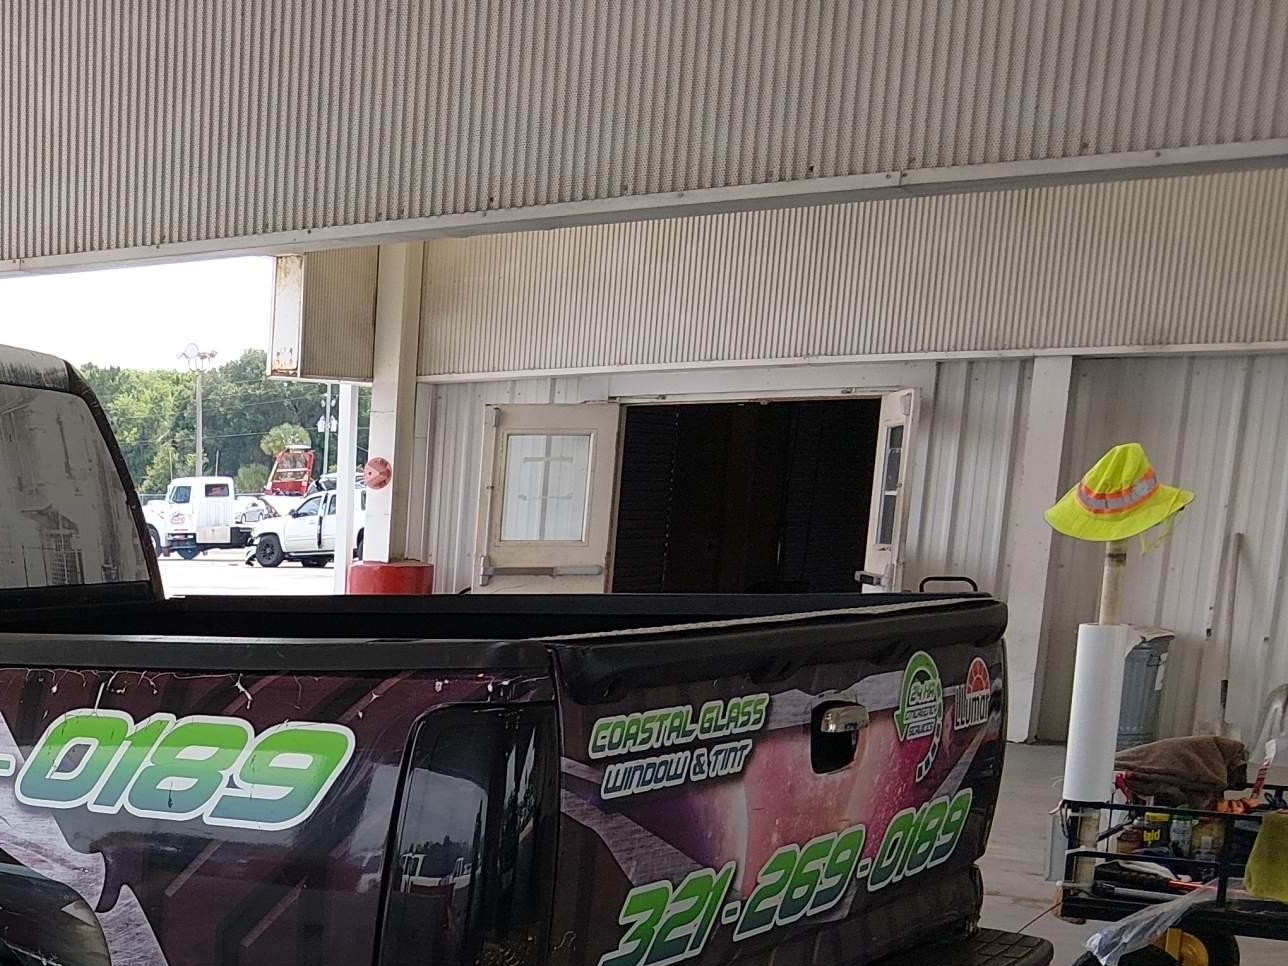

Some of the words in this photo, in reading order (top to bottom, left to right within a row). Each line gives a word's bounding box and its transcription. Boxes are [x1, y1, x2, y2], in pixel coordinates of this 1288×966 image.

[588, 705, 699, 759] COASTAL
[698, 693, 770, 740] GLASS
[601, 750, 692, 800] WINDOW
[690, 748, 709, 781] &
[708, 739, 753, 778] TINT
